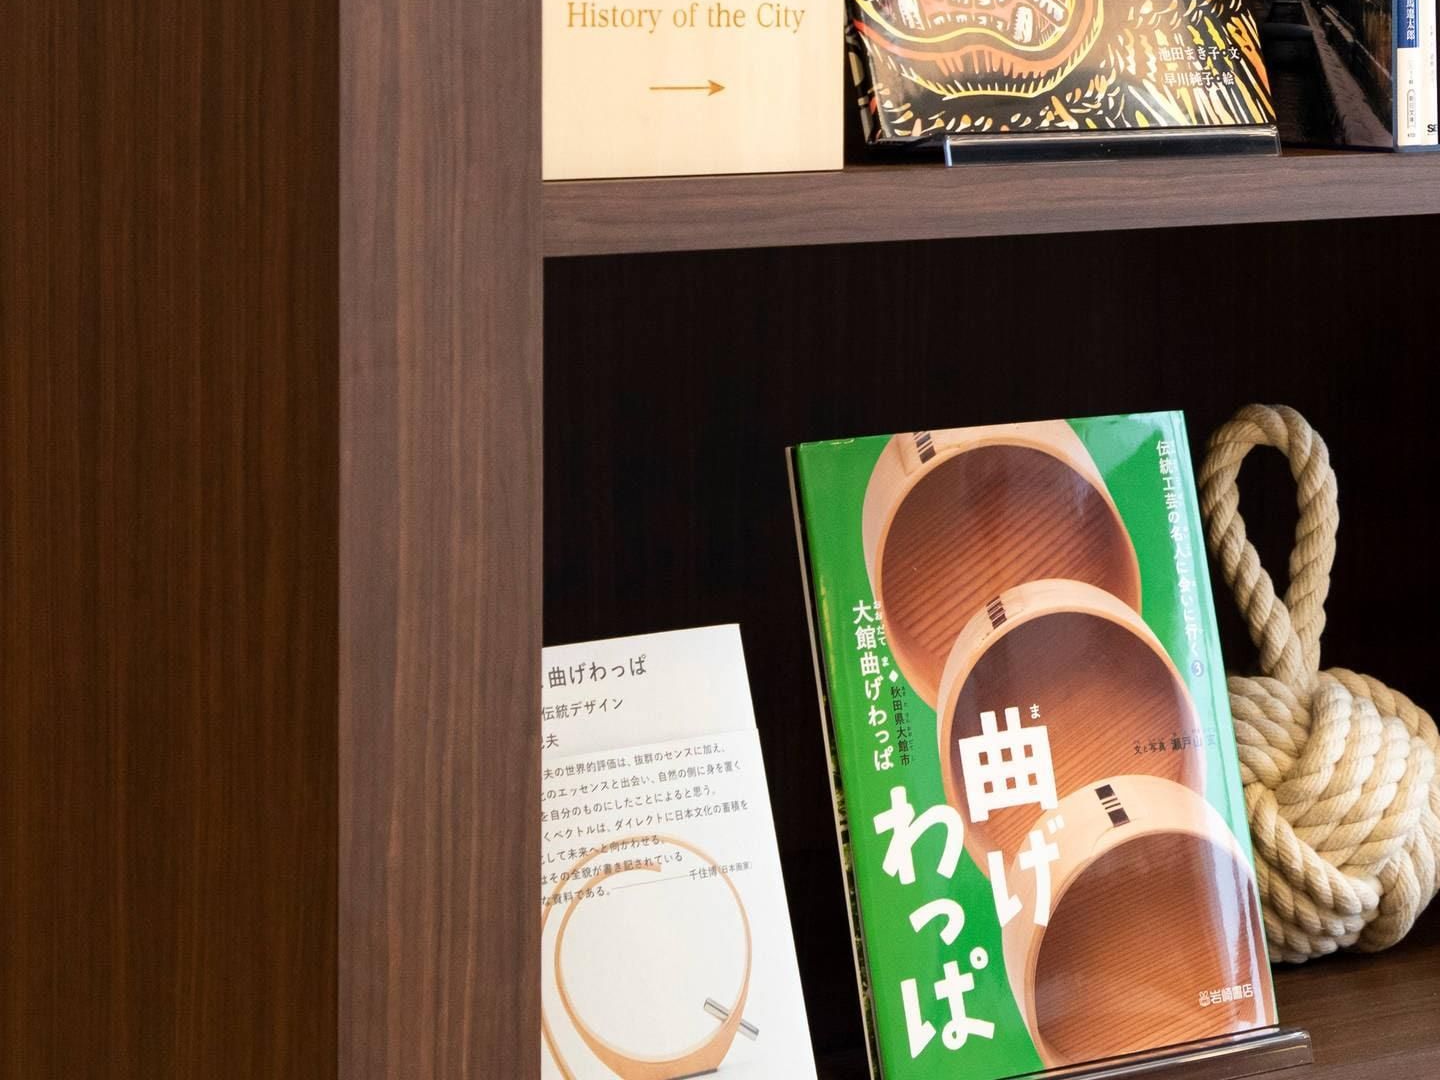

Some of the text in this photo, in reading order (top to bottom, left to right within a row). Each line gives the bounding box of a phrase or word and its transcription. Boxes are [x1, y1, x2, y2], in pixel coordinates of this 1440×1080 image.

[567, 1, 806, 34] History of the City
[1156, 440, 1200, 655] 伝統工芸の名人に会いに行く
[541, 654, 648, 689] 曲げわっぱ
[542, 698, 624, 721] 伝統デザイン
[853, 600, 894, 771] 大館曲げわっぱ
[1030, 704, 1041, 719] ま
[891, 685, 911, 767] 秋田県大館市
[958, 706, 1066, 928] 曲げ
[873, 786, 995, 1060] わっぱ
